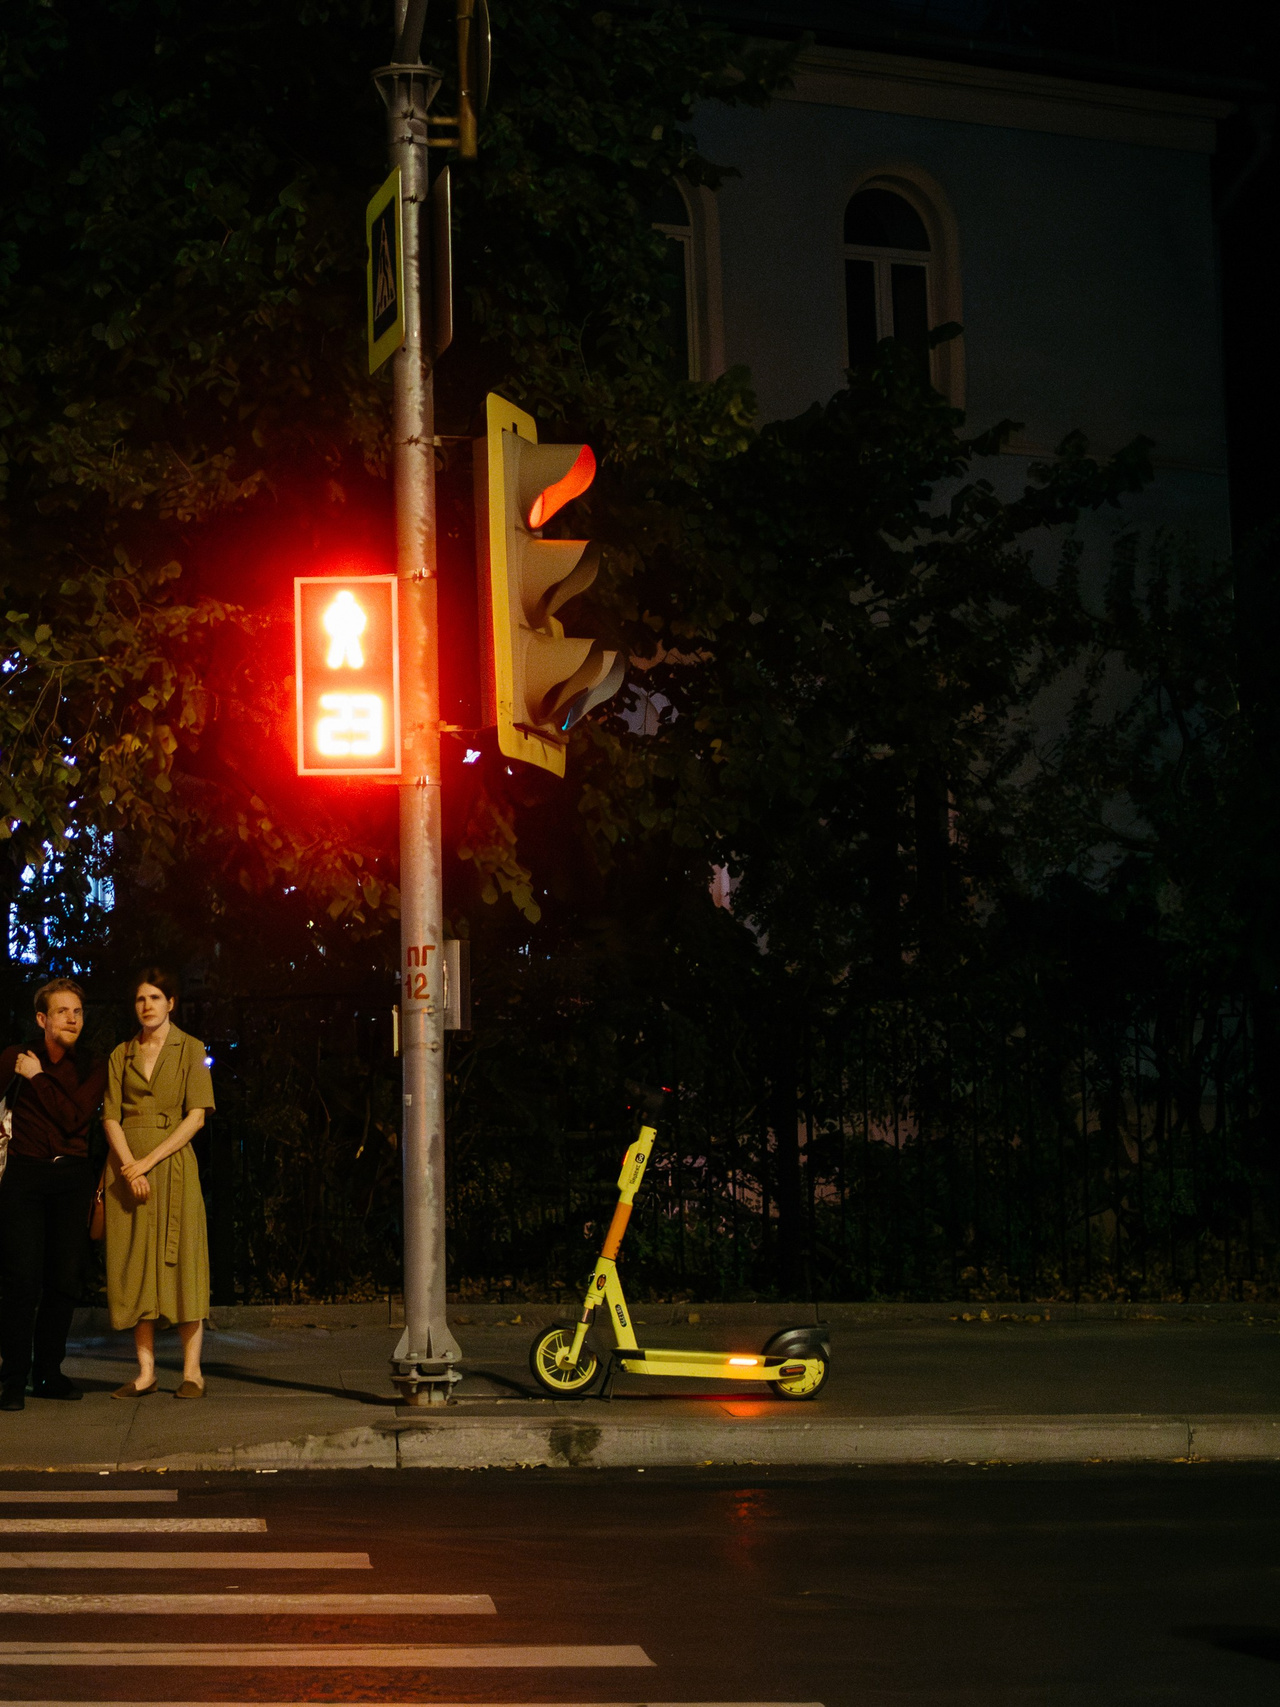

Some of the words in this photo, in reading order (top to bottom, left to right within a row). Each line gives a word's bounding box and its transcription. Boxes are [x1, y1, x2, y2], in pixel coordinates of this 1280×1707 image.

[317, 693, 382, 755] 23
[407, 945, 436, 967] ПГ
[405, 972, 430, 1000] 12
